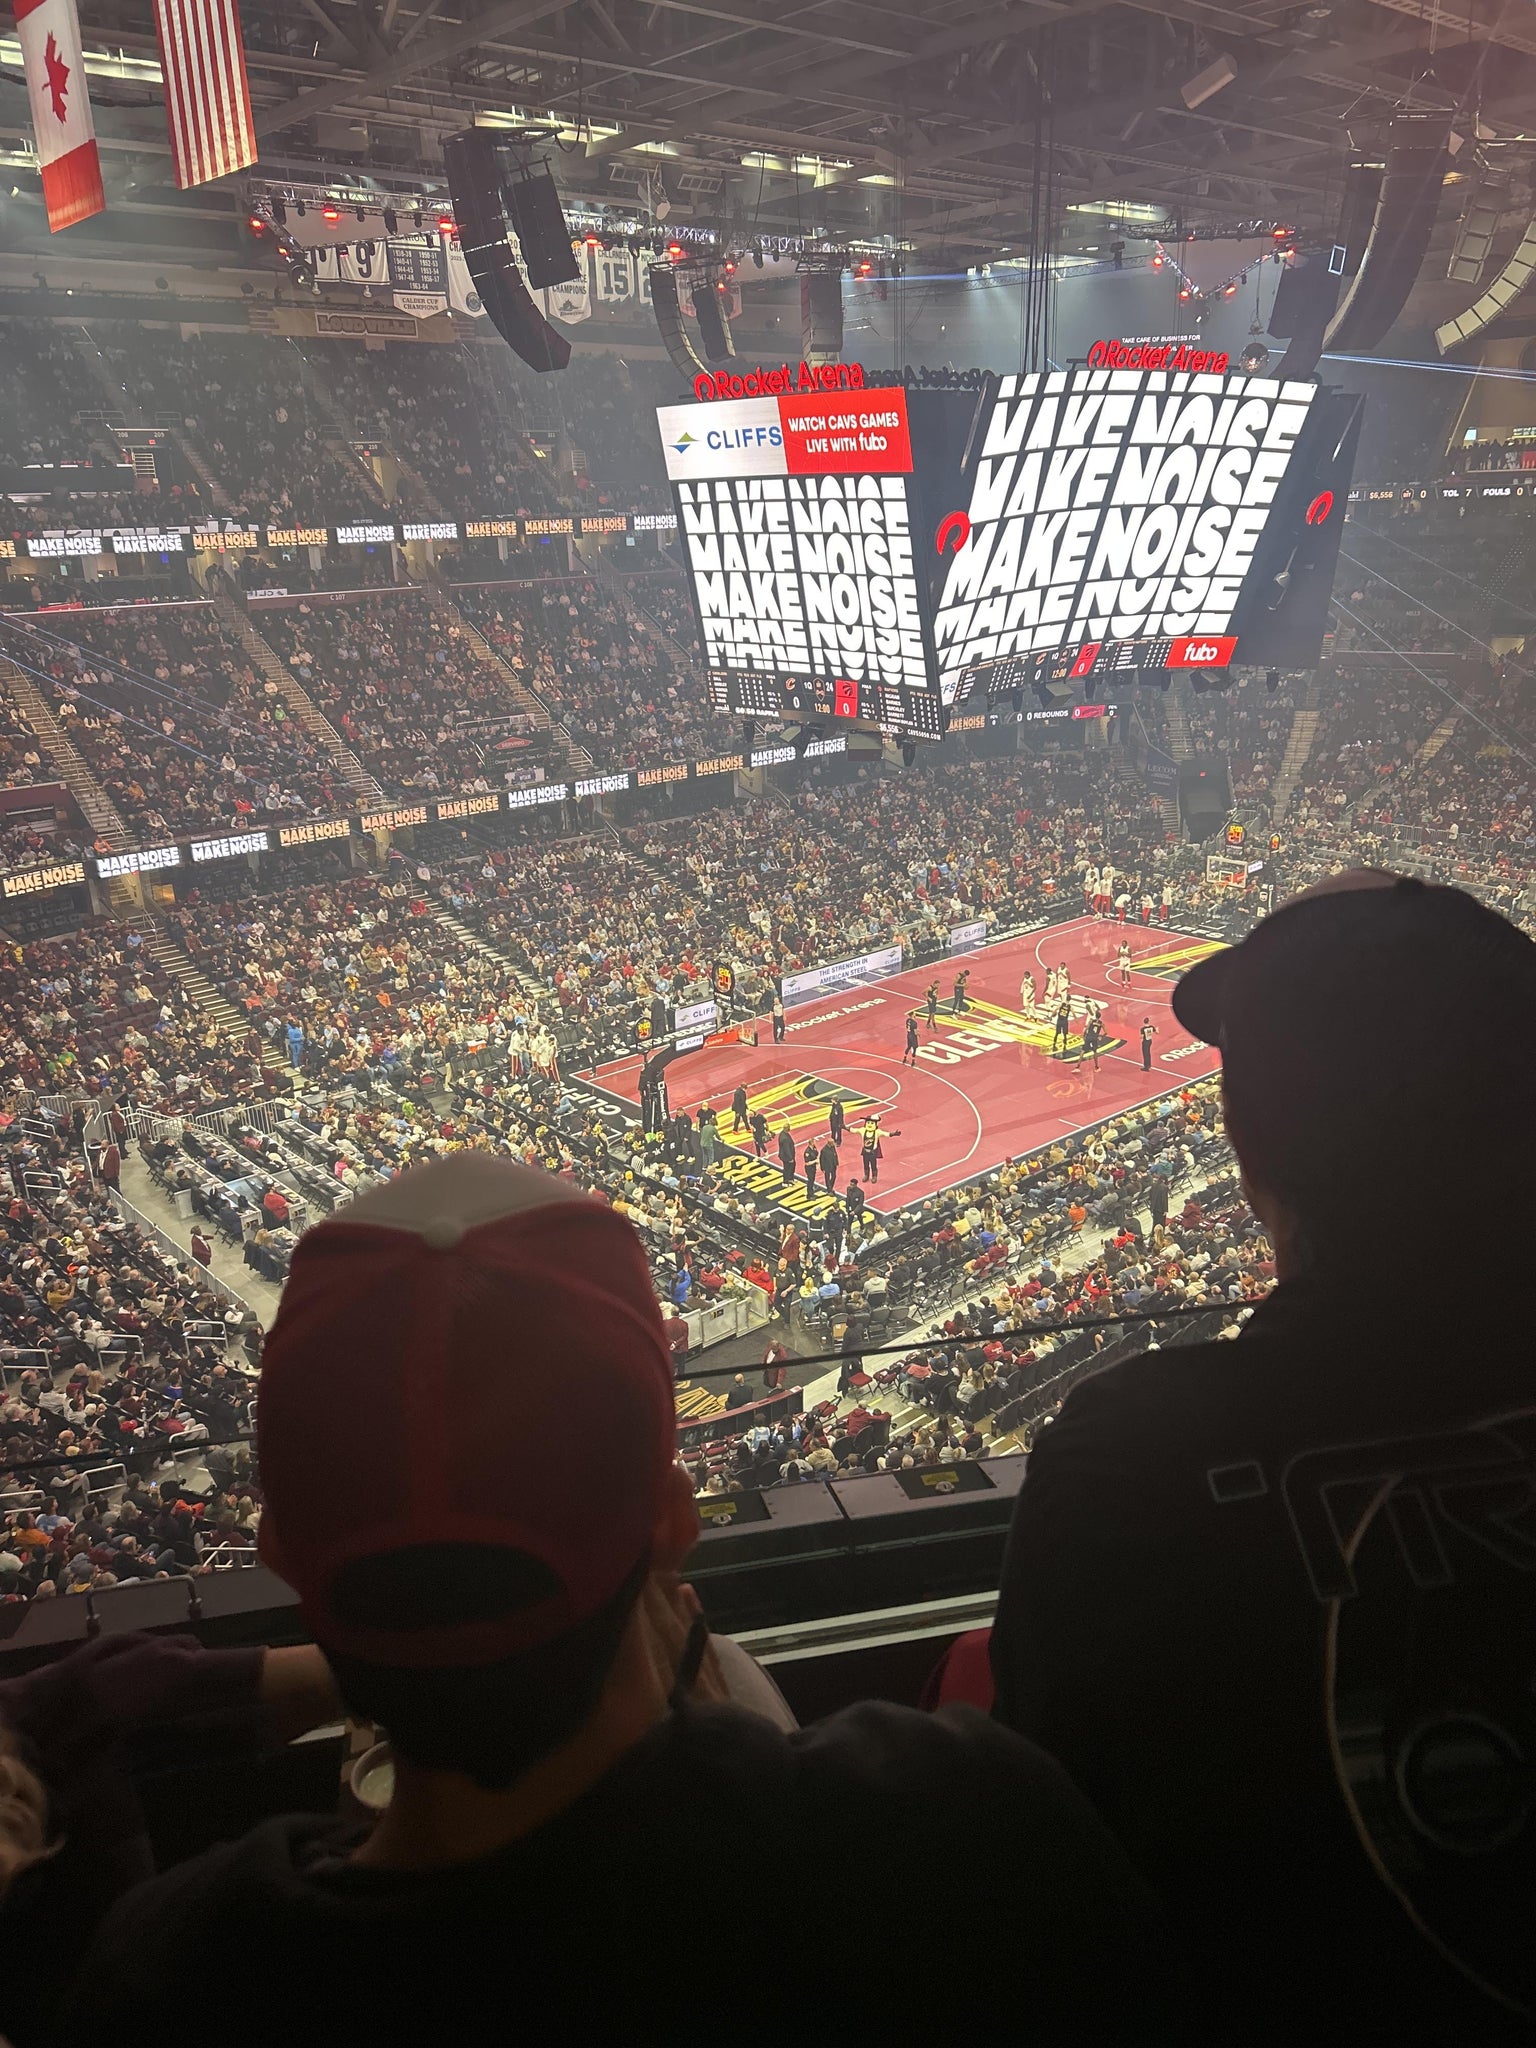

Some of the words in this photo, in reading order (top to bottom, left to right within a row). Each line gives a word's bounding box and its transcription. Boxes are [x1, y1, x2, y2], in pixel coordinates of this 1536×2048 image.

[356, 242, 372, 278] 9
[602, 262, 629, 296] 15
[552, 284, 587, 295] CHAMPIONS
[403, 303, 439, 311] CHAMPIONS
[1104, 339, 1171, 370] Rocket
[1169, 344, 1230, 374] Arena
[714, 364, 794, 400] Rocket
[797, 361, 864, 393] Arena
[788, 416, 826, 433] WATCH
[828, 413, 857, 430] CAVS
[859, 411, 900, 429] GAMES
[706, 425, 784, 450] CLIFFS
[806, 439, 831, 454] LIVE
[831, 437, 857, 452] WITH
[858, 432, 888, 452] fubo
[1369, 491, 1394, 499] $6,556
[1420, 490, 1427, 499] 0
[1443, 489, 1460, 497] TOL
[1465, 488, 1473, 497] 7
[1483, 487, 1511, 496] FOULS
[1516, 487, 1524, 496] 0
[466, 522, 492, 535] MAKE
[491, 521, 517, 534] NOISE
[524, 520, 550, 533] MAKE
[549, 519, 574, 532] NOISE
[581, 519, 604, 531] MAKE
[603, 518, 627, 530] NOISE
[633, 515, 655, 527] MAKE
[655, 514, 678, 526] NOISE
[193, 534, 225, 548] MAKE
[225, 532, 258, 546] NOISE
[267, 530, 298, 544] MAKE
[298, 528, 328, 542] NOISE
[336, 526, 365, 539] MAKE
[365, 525, 395, 538] NOISE
[403, 527, 430, 540] MAKE
[430, 526, 458, 539] NOISE
[27, 537, 65, 552] MAKE
[64, 536, 102, 551] NOISE
[113, 539, 148, 553] MAKE
[148, 538, 183, 552] NOISE
[939, 508, 1102, 609] MAKE
[1087, 504, 1271, 580] NOISE
[693, 571, 804, 622] MAKE
[801, 573, 922, 631] NOISE
[1183, 641, 1218, 662] fubo
[1034, 669, 1042, 680] 0
[1078, 662, 1085, 673] 0
[803, 681, 813, 690] 1Q
[825, 681, 834, 692] 24
[793, 696, 800, 709] 0
[814, 703, 831, 714] 12:00
[843, 702, 850, 714] 0
[1017, 713, 1023, 722] 0
[1026, 712, 1033, 721] 0
[1033, 709, 1069, 719] REBOUNDS
[1074, 706, 1081, 716] 0
[948, 719, 964, 731] AKE
[963, 715, 986, 729] NOISE
[751, 751, 774, 764] MAKE
[773, 748, 796, 760] NOISE
[825, 743, 846, 754] NOISE
[696, 760, 719, 774] MAKE
[719, 756, 744, 770] NOISE
[638, 769, 662, 784] MAKE
[662, 765, 688, 781] NOISE
[508, 788, 538, 803] MAKE
[538, 784, 568, 799] NOISE
[575, 781, 602, 796] MAKE
[602, 776, 629, 791] NOISE
[437, 801, 468, 818] MAKE
[468, 796, 499, 812] NOISE
[362, 813, 394, 830] MAKE
[393, 808, 427, 825] NOISE
[279, 825, 315, 843] MAKE
[314, 821, 351, 838] NOISE
[192, 842, 230, 862] MAKE
[230, 836, 269, 856] NOISE
[98, 854, 139, 873] MAKE
[138, 846, 180, 865] NOISE
[3, 873, 43, 894] MAKE
[42, 864, 85, 885] NOISE
[963, 926, 985, 938] CLIFFS
[819, 968, 830, 977] THE
[831, 959, 861, 974] STRENGTH
[819, 970, 850, 985] AMERICAN
[850, 965, 868, 976] STEEL
[692, 1006, 716, 1018] CLIFF
[791, 1010, 846, 1031] Rocket
[841, 997, 888, 1014] Arena
